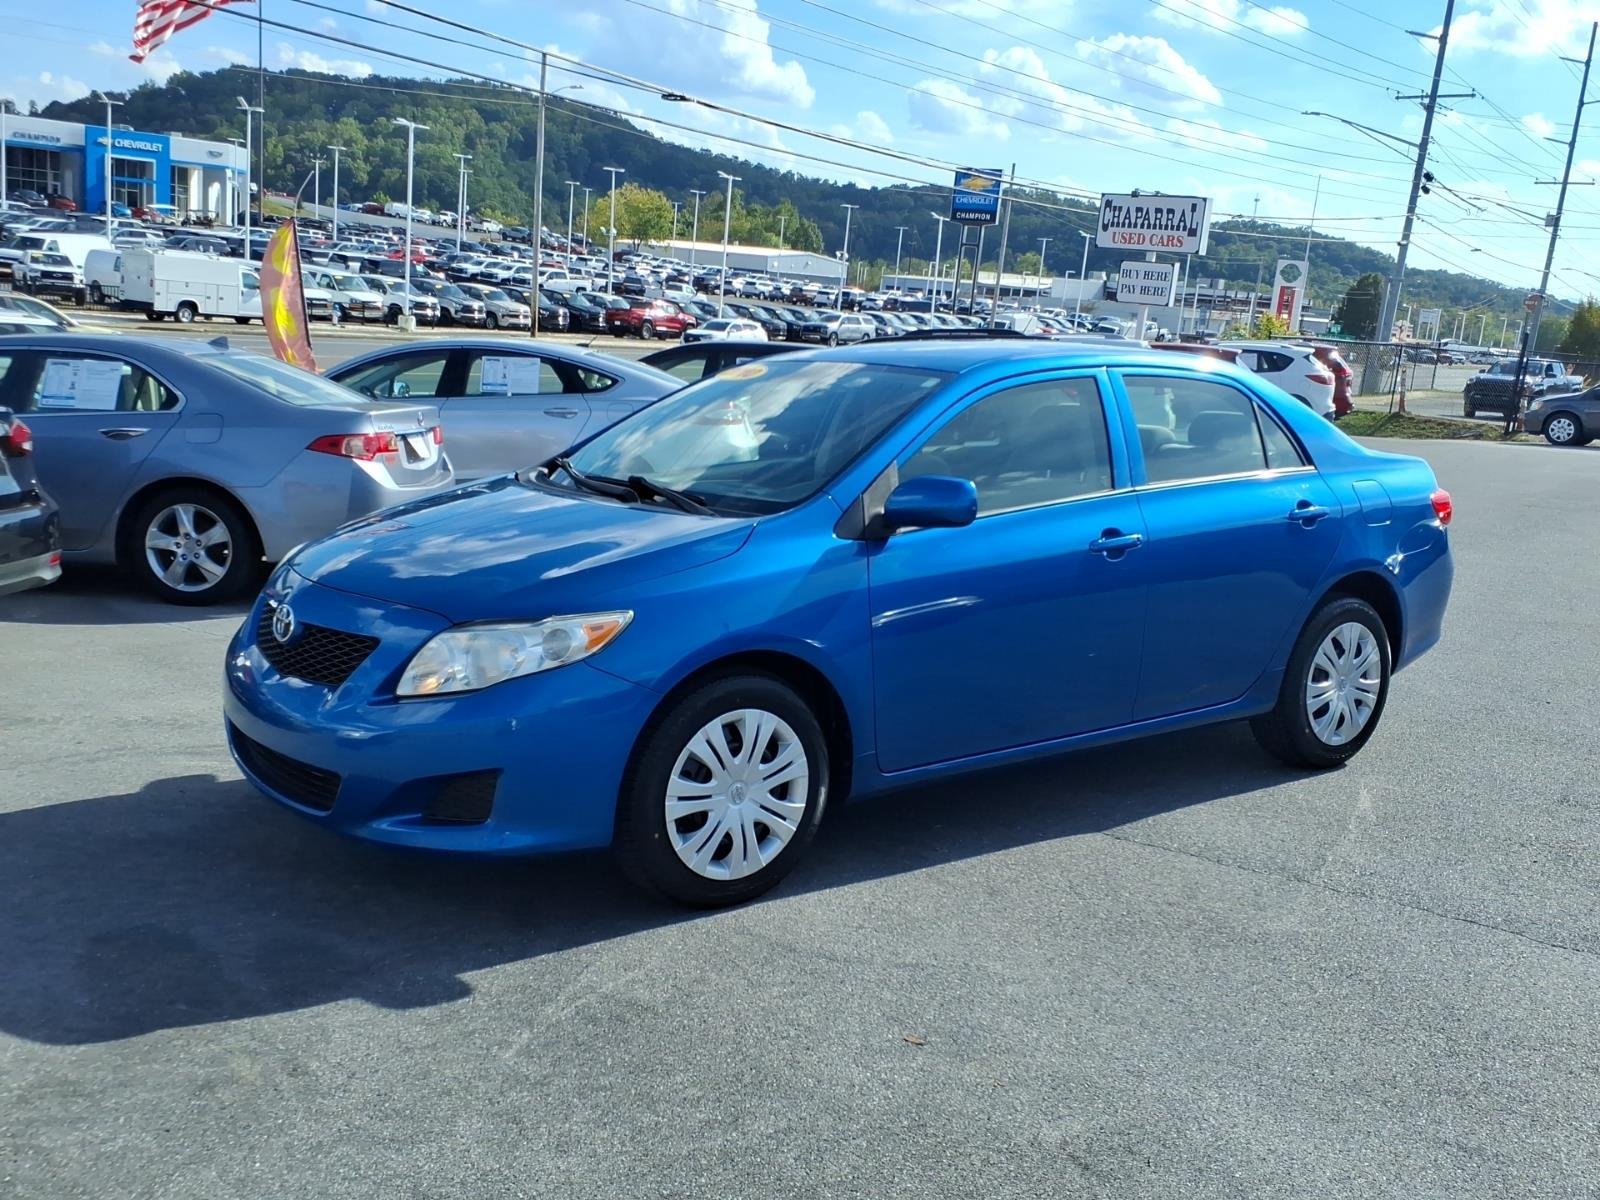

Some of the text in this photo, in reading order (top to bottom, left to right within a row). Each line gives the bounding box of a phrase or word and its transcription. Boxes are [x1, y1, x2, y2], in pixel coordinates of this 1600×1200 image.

[115, 138, 163, 152] CHEVROLET
[955, 195, 994, 205] CHEVROLET
[956, 211, 991, 221] CHAMPION
[1101, 198, 1199, 238] CHAPARRAL
[1111, 231, 1185, 248] USED CARS
[1121, 268, 1171, 282] BUY HERE
[1120, 283, 1168, 297] PAY HERE
